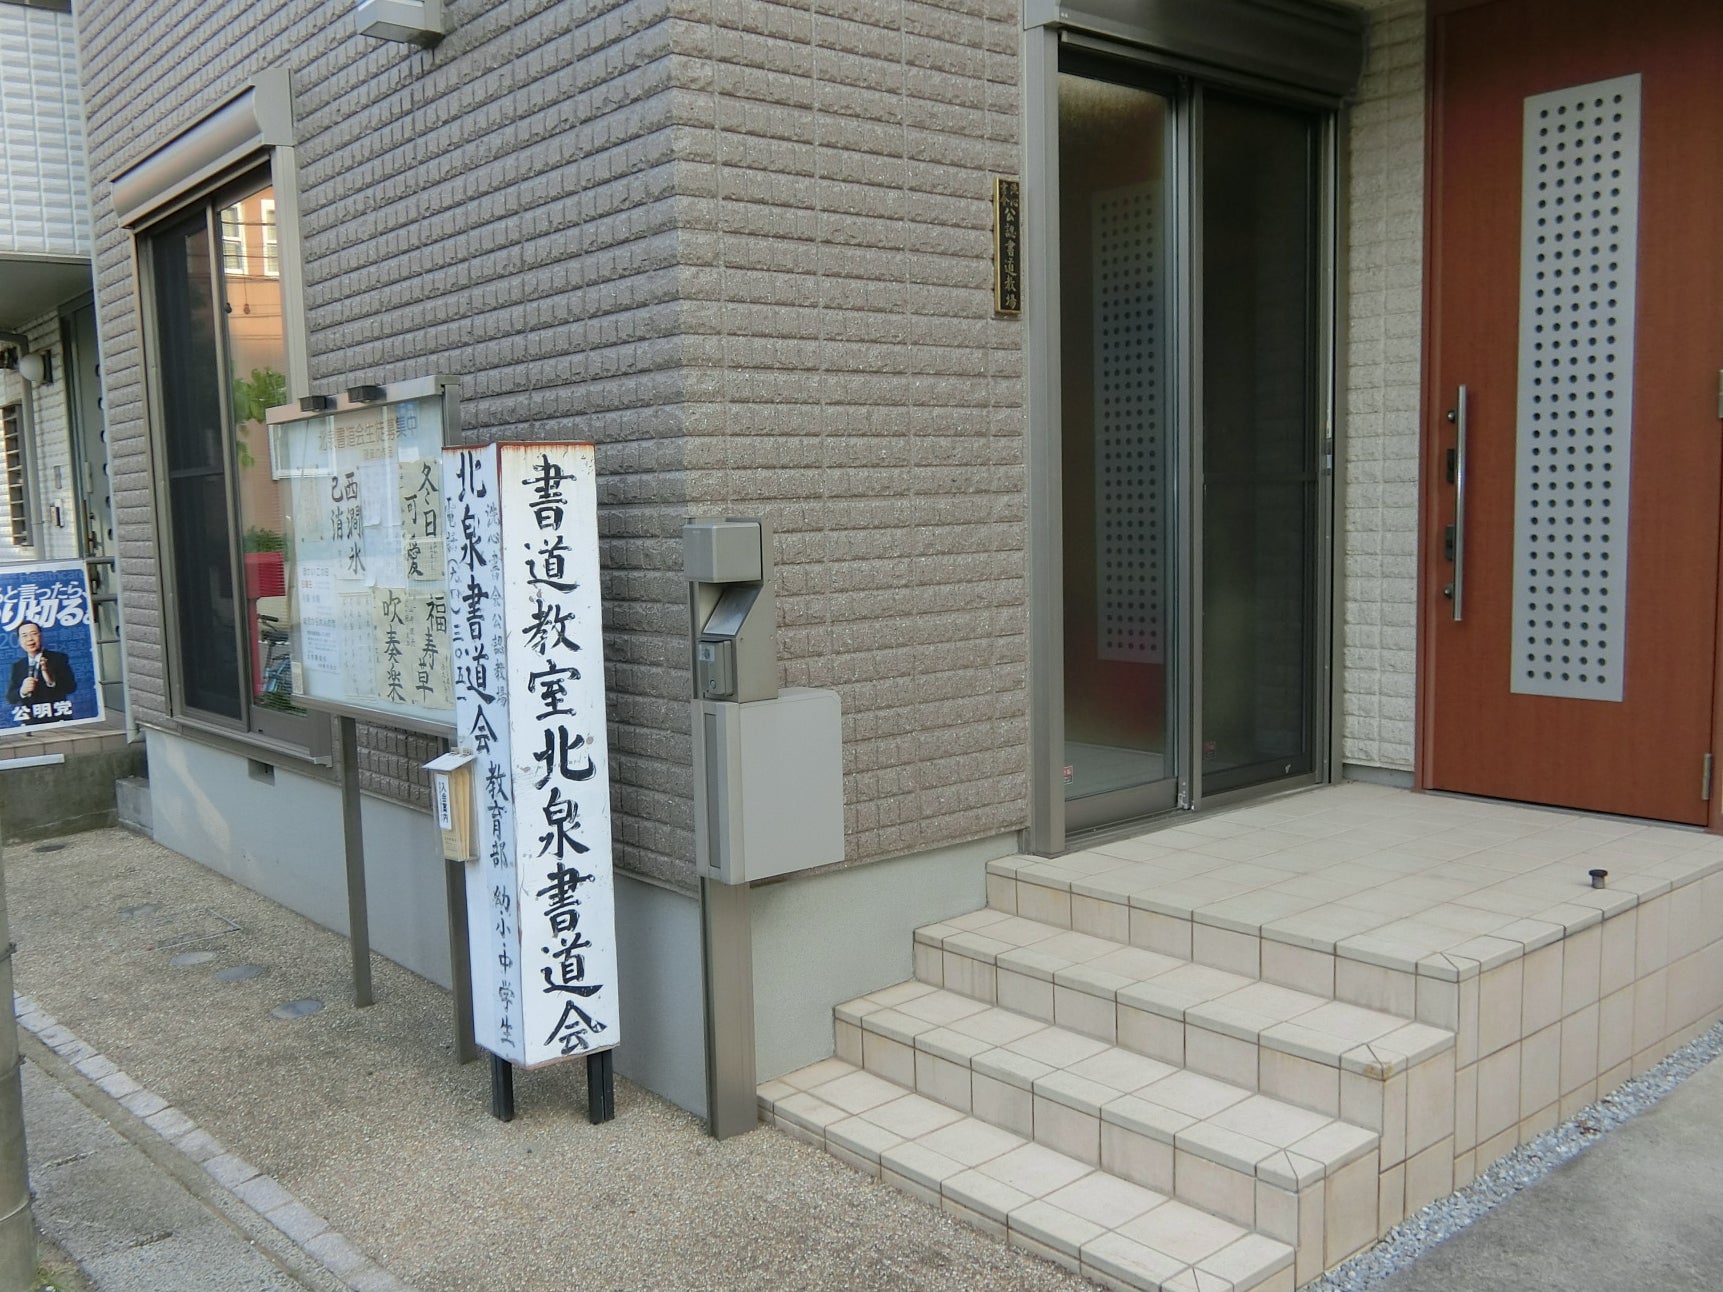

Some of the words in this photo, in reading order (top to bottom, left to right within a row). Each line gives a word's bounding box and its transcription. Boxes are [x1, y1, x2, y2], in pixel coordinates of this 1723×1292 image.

[418, 462, 439, 538] 冬日
[0, 582, 88, 604] と言ったら、
[382, 589, 406, 702] 吹奏楽
[416, 595, 447, 702] 福寿草
[456, 450, 497, 755] 北泉書道会
[486, 761, 509, 869] 教育部
[11, 700, 73, 721] 公明党
[521, 453, 608, 1055] 書道教室北泉書道会
